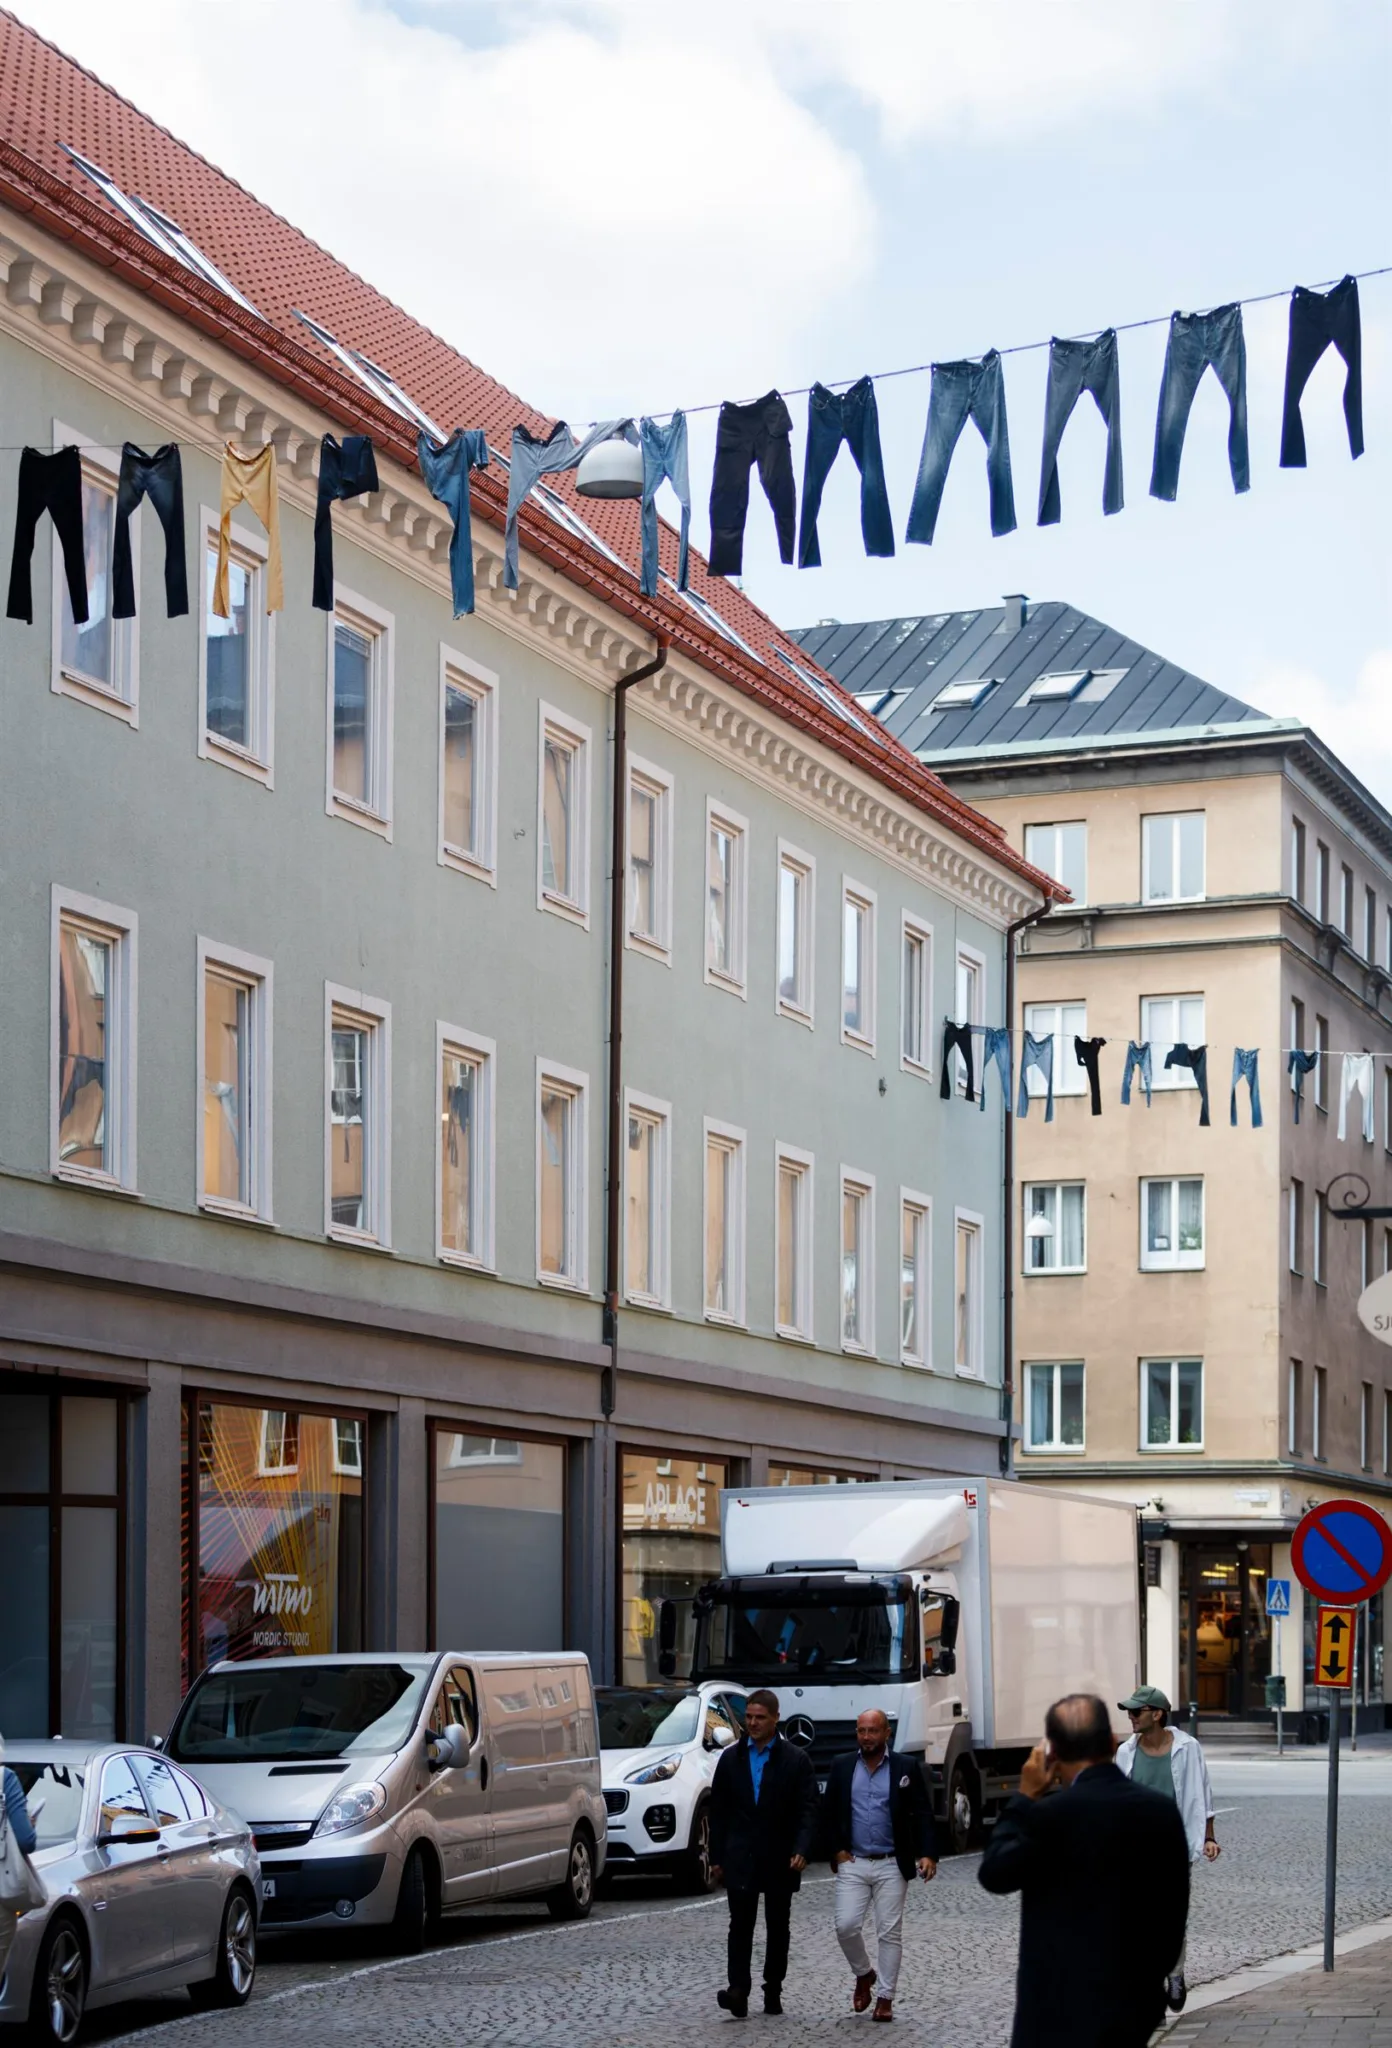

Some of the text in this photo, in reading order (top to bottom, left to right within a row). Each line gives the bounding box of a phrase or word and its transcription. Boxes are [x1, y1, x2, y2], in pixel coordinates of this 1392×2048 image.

[1374, 1314, 1392, 1331] SJ
[645, 1482, 706, 1525] APLACE
[253, 1631, 310, 1646] NORDIC STUDIO
